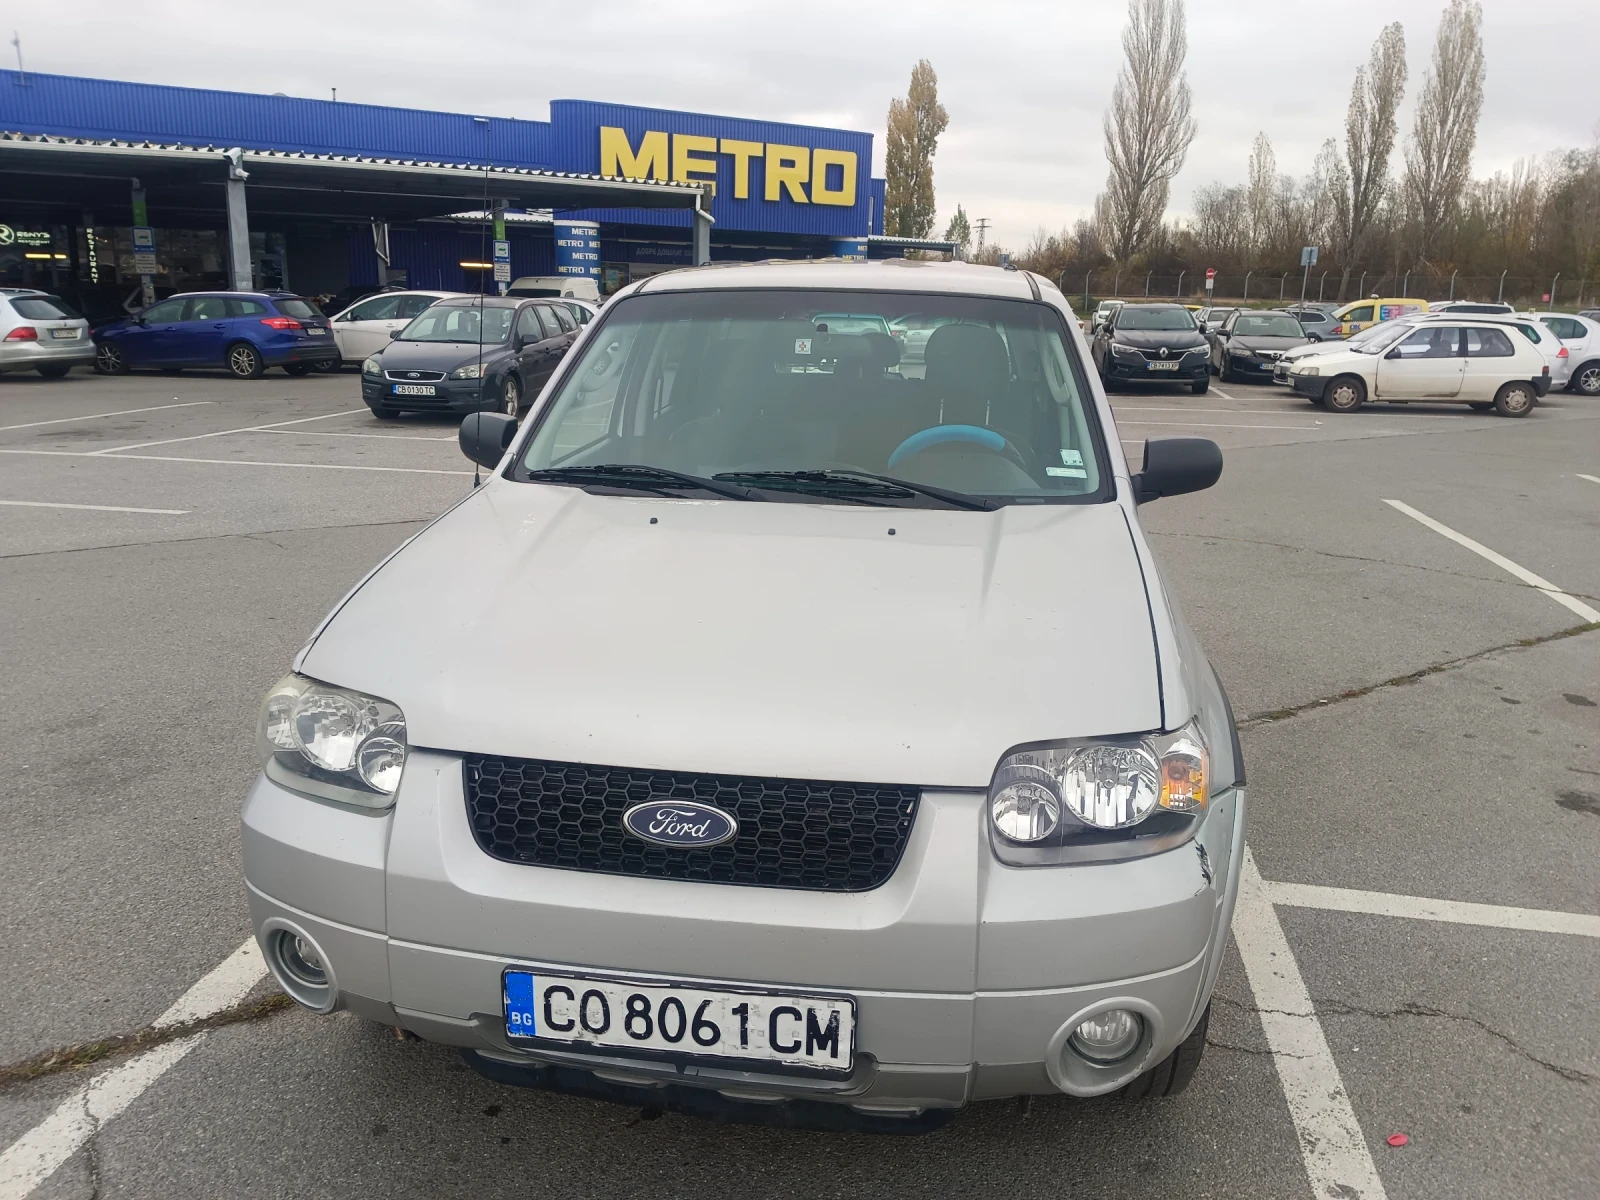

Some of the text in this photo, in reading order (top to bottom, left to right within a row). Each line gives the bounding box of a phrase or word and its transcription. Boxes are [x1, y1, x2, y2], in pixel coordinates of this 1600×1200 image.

[600, 126, 857, 207] METRO
[86, 228, 98, 284] RESTAURANT
[648, 808, 712, 838] Ford
[511, 1011, 533, 1026] BG
[543, 984, 841, 1060] CO 8061 CM
